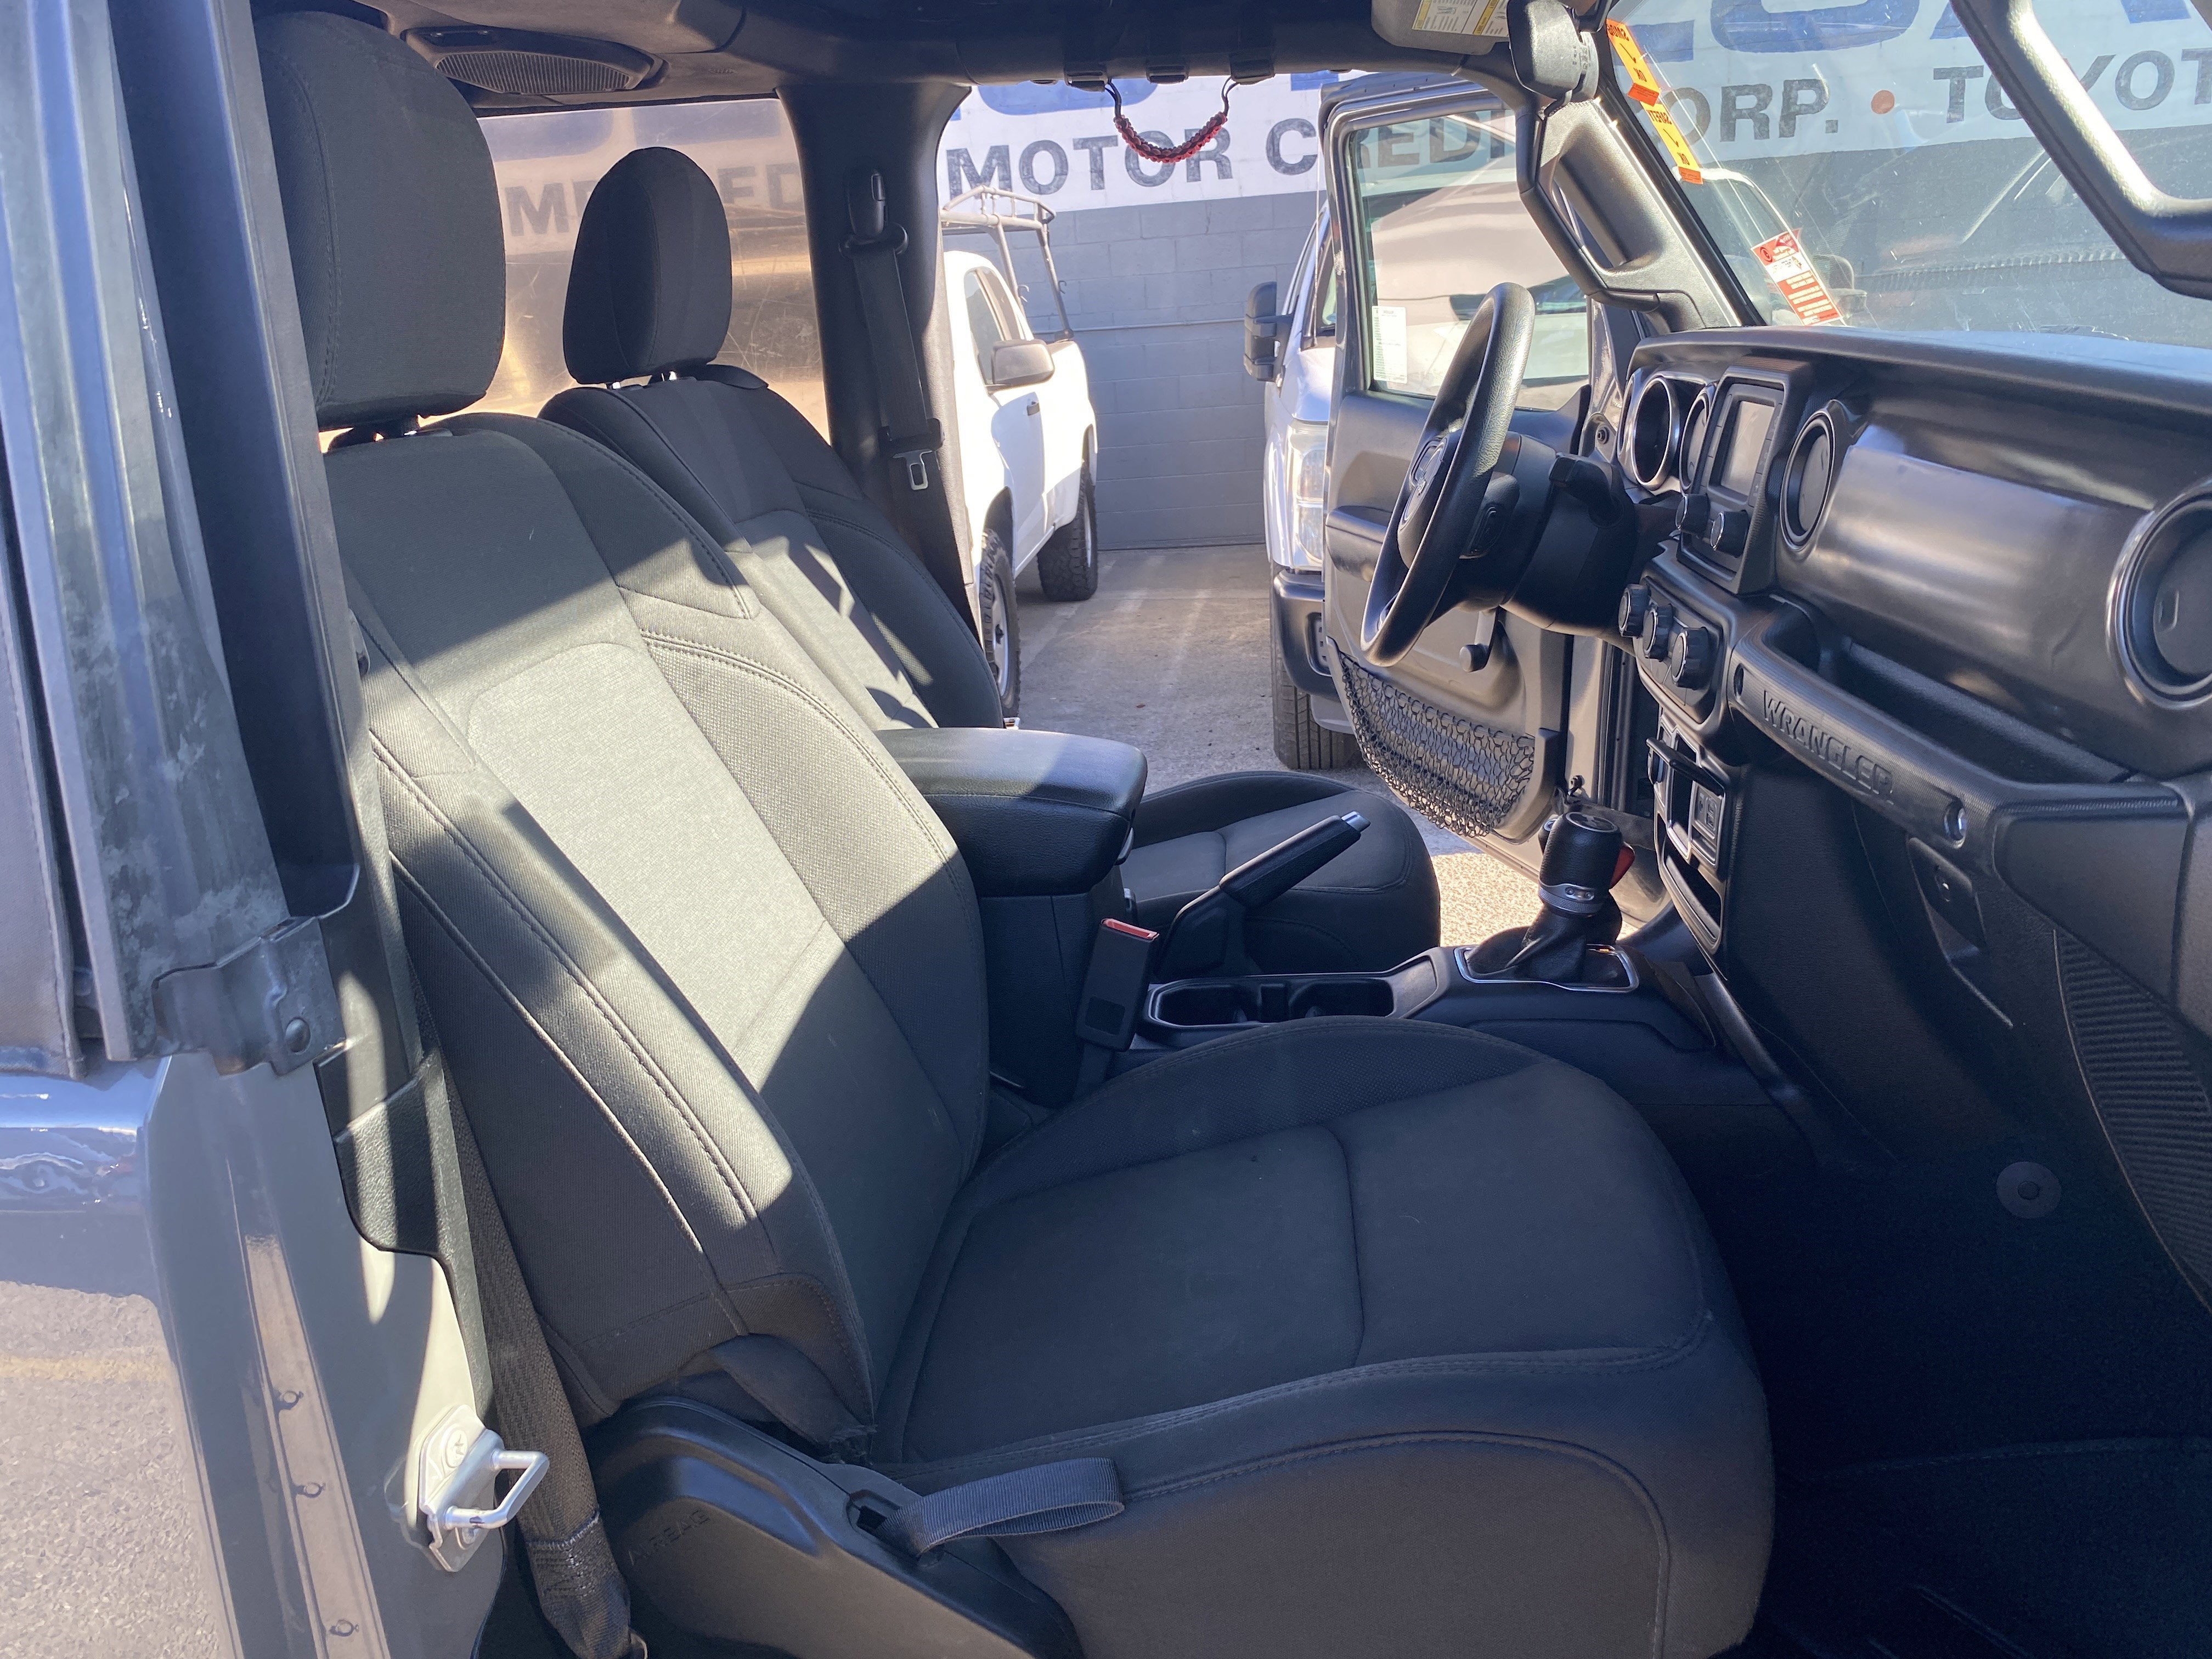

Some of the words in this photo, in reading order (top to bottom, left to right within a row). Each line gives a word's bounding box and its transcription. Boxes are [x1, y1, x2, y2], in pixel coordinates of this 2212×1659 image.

[946, 128, 1233, 201] MOTOR
[1266, 109, 1505, 176] CEDI
[1637, 78, 1838, 145] ORP.
[1763, 690, 1895, 805] WRANGLER
